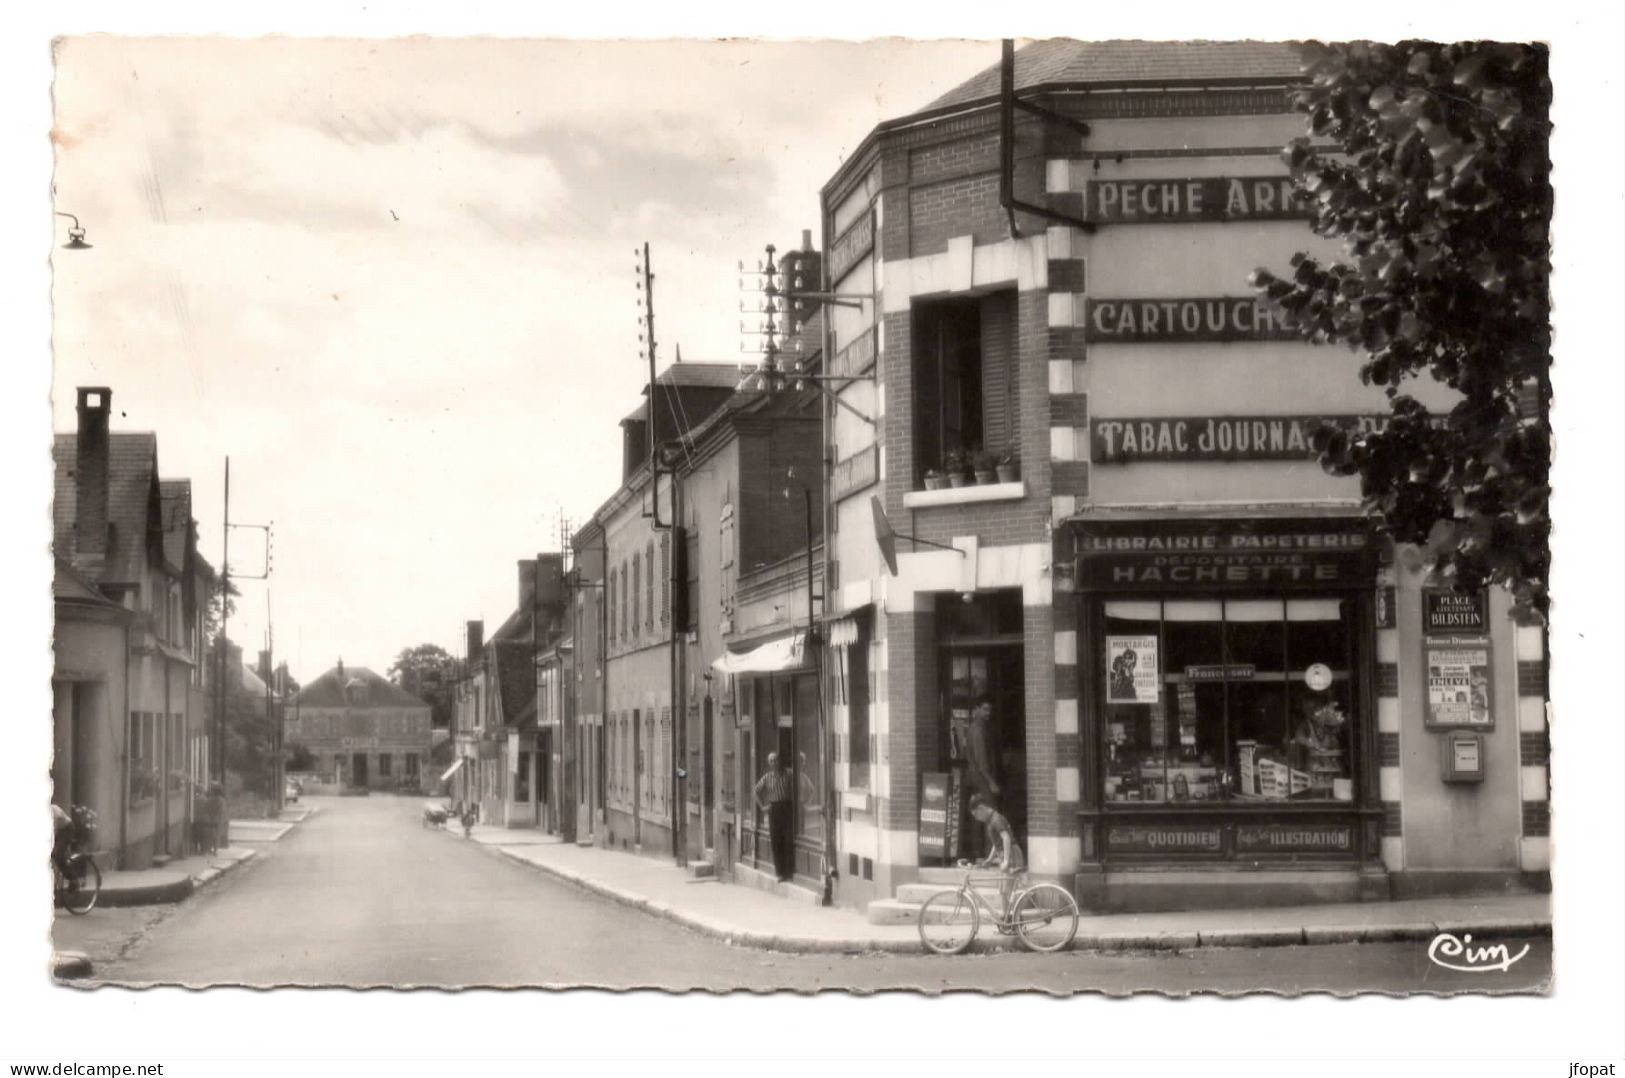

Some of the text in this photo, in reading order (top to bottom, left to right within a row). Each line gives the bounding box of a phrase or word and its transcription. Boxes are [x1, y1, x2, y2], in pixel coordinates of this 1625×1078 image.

[1099, 179, 1306, 218] PECHE ARM
[1098, 420, 1188, 457] TABAC
[1198, 418, 1313, 453] JOURNA
[1092, 533, 1367, 550] LIBRAIRIE PAPETERIE
[1112, 564, 1339, 583] HACHETTE
[1440, 596, 1470, 605] PLACE
[1431, 613, 1481, 625] BILDSTEIN
